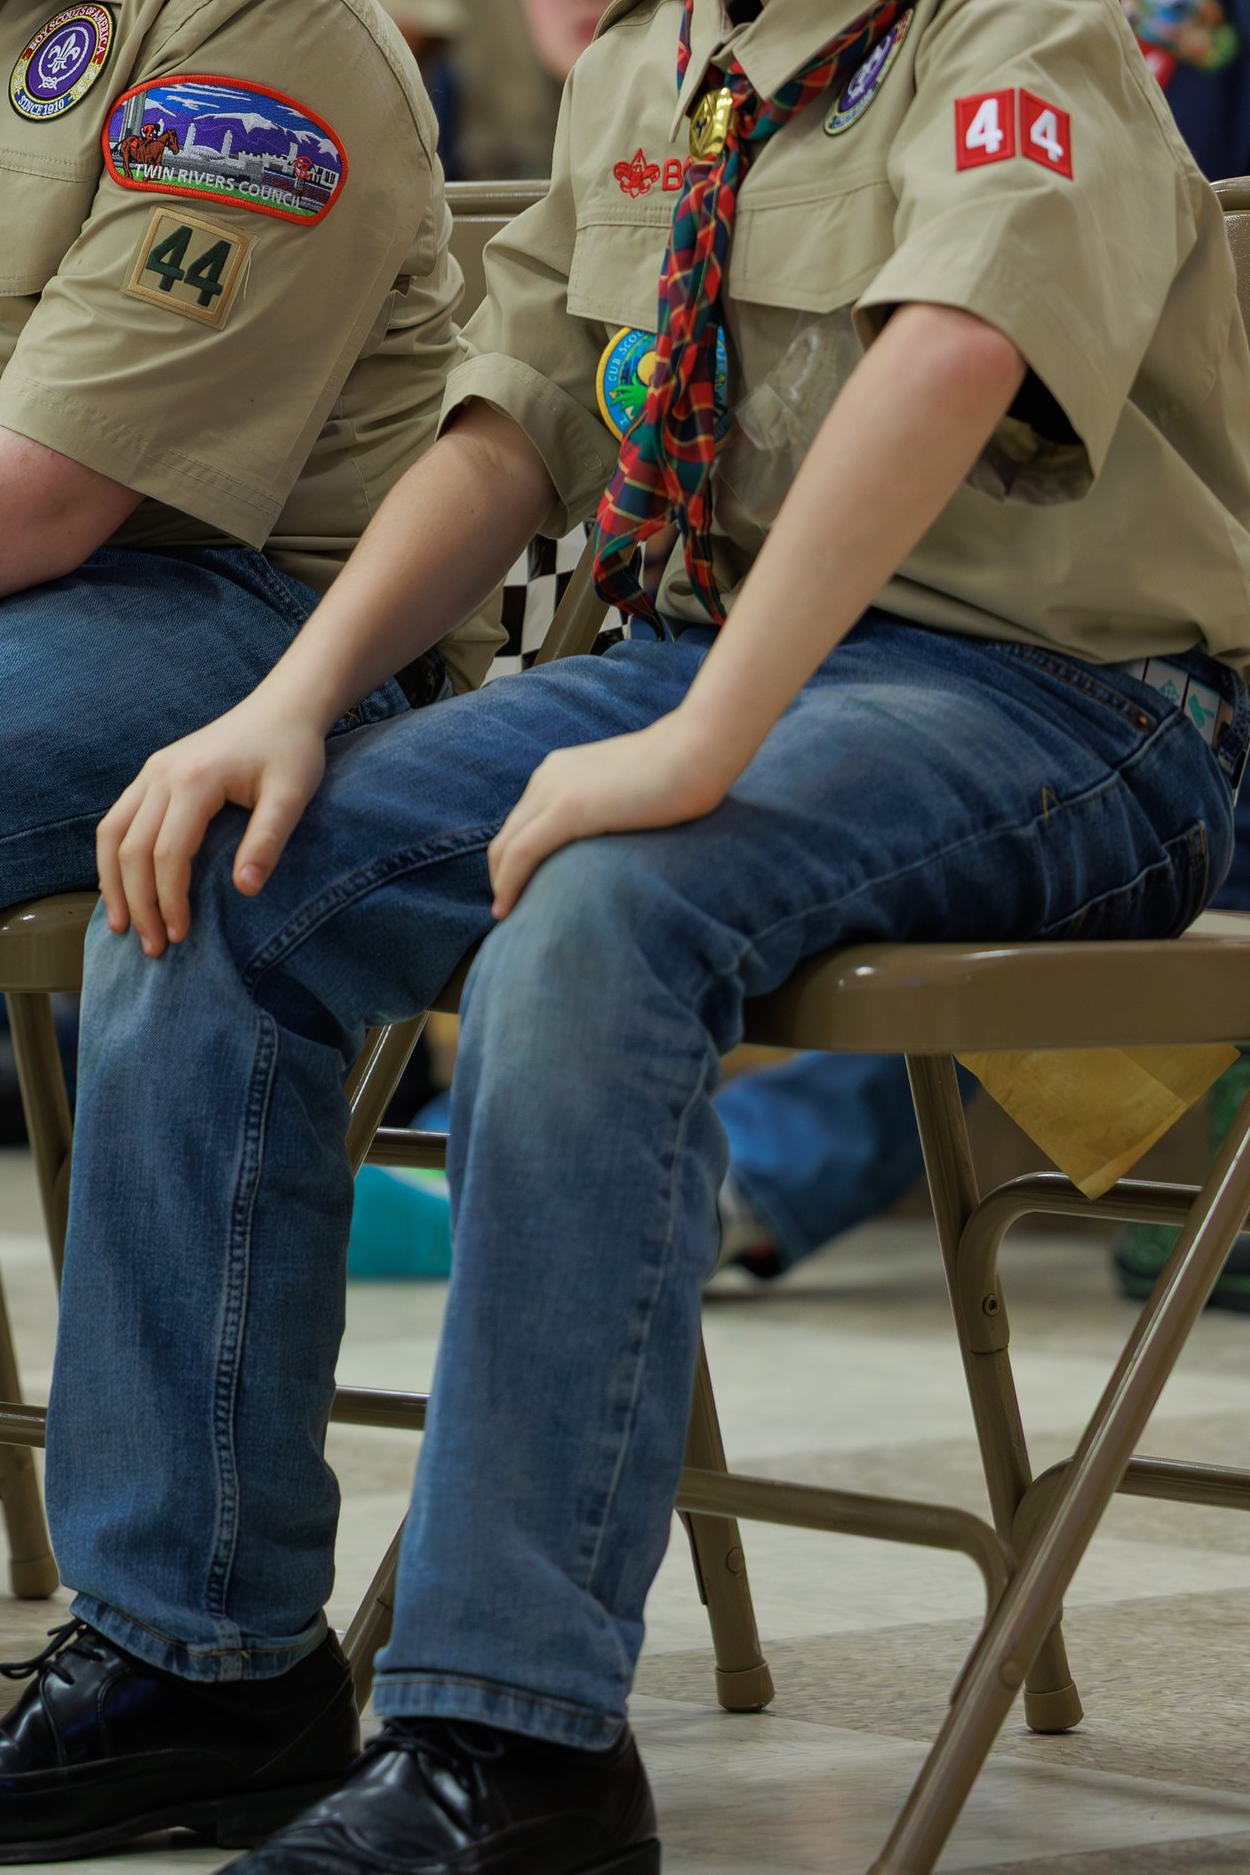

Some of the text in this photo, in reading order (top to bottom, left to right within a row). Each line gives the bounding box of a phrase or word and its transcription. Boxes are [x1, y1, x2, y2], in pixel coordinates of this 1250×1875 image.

[29, 6, 108, 55] BOY SCOUTS OF AMERICA
[18, 95, 65, 116] SINCE 1910
[135, 163, 301, 210] TWIN RIVERS COUNCIL
[145, 225, 232, 307] 44
[608, 358, 621, 382] CUB
